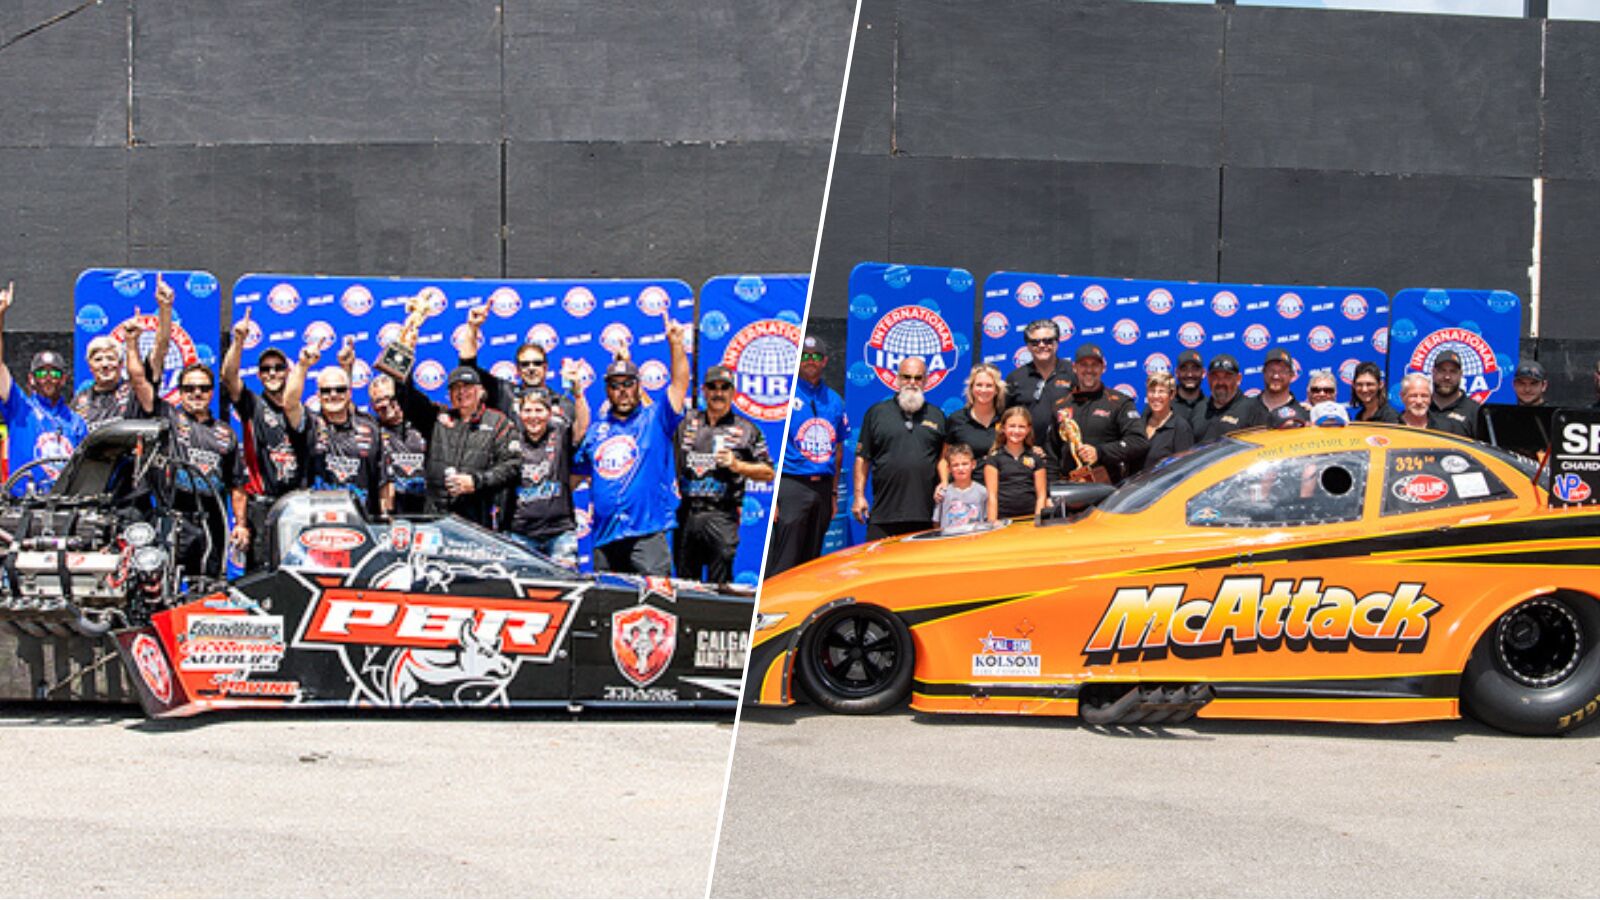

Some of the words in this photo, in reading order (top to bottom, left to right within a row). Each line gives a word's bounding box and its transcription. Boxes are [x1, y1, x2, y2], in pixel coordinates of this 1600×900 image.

[724, 321, 801, 364] INTERNATIO
[872, 307, 952, 346] INTERNATIONAL
[876, 350, 946, 371] IHA
[1412, 329, 1494, 368] INTERNATIONAL
[1395, 456, 1423, 472] 324
[1555, 473, 1581, 500] VP
[319, 600, 552, 646] PBR
[1083, 574, 1443, 667] McAttack
[697, 631, 749, 650] CALGA
